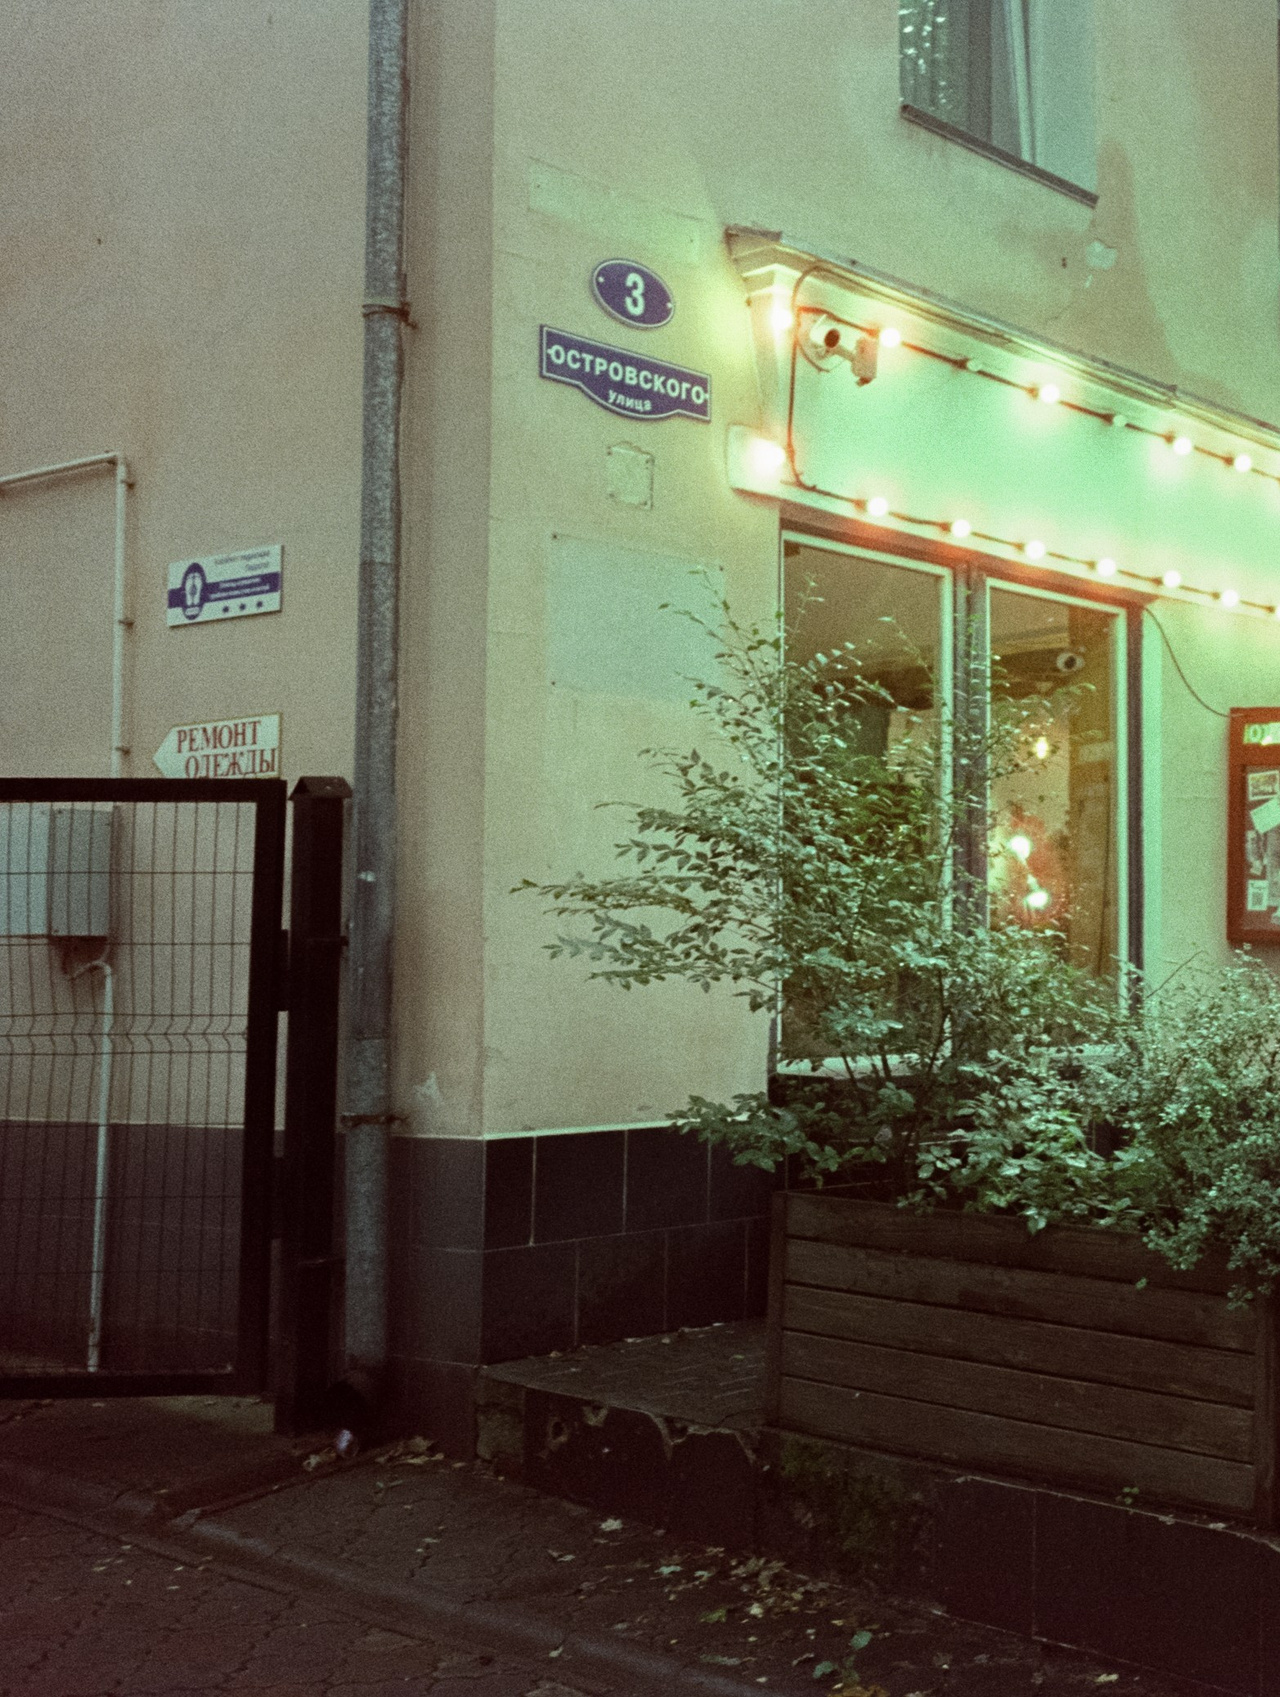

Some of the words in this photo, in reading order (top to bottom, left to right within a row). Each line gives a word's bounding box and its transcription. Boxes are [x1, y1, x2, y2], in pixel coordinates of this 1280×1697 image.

[625, 273, 646, 316] 3
[550, 344, 704, 404] ОСТРОВСКОГО
[608, 389, 652, 412] улица
[177, 721, 261, 753] РЕМОНТ
[185, 748, 276, 779] ОДЕЖДЫ
